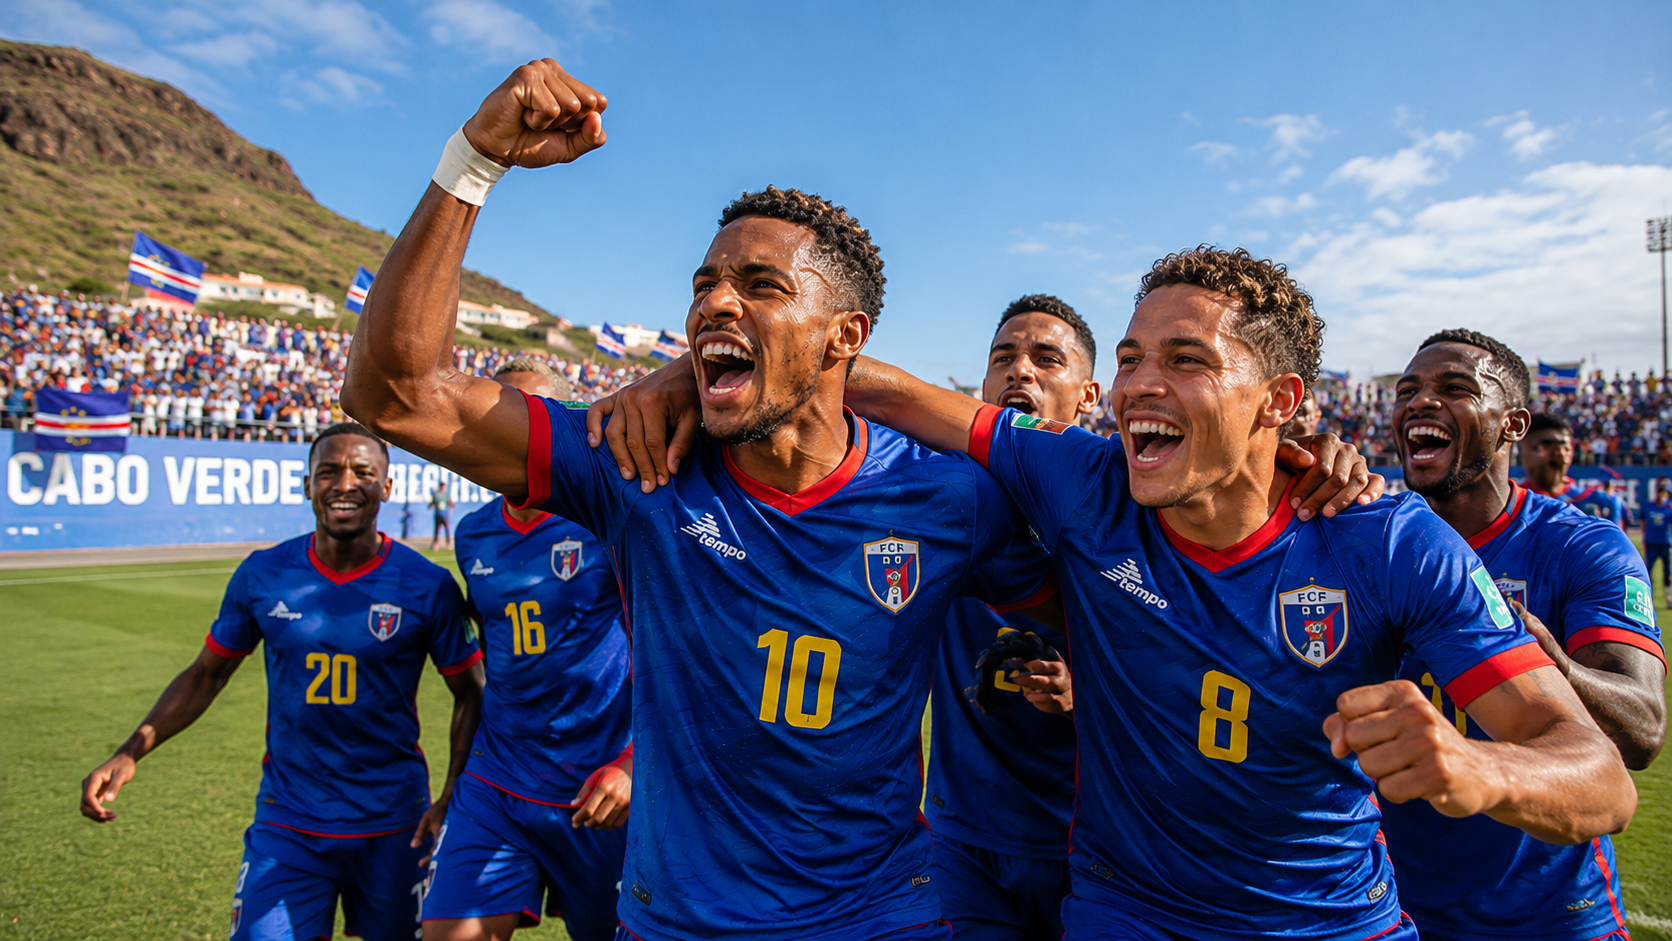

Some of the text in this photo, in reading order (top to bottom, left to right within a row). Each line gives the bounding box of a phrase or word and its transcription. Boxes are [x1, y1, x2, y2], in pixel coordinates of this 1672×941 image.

[7, 451, 305, 505] CABO VERDE
[698, 533, 746, 560] tempo
[1119, 577, 1168, 609] tempo
[1297, 591, 1326, 603] FCF
[505, 600, 546, 655] 16
[306, 652, 357, 704] 20
[757, 628, 842, 729] 10
[1198, 670, 1251, 763] 8
